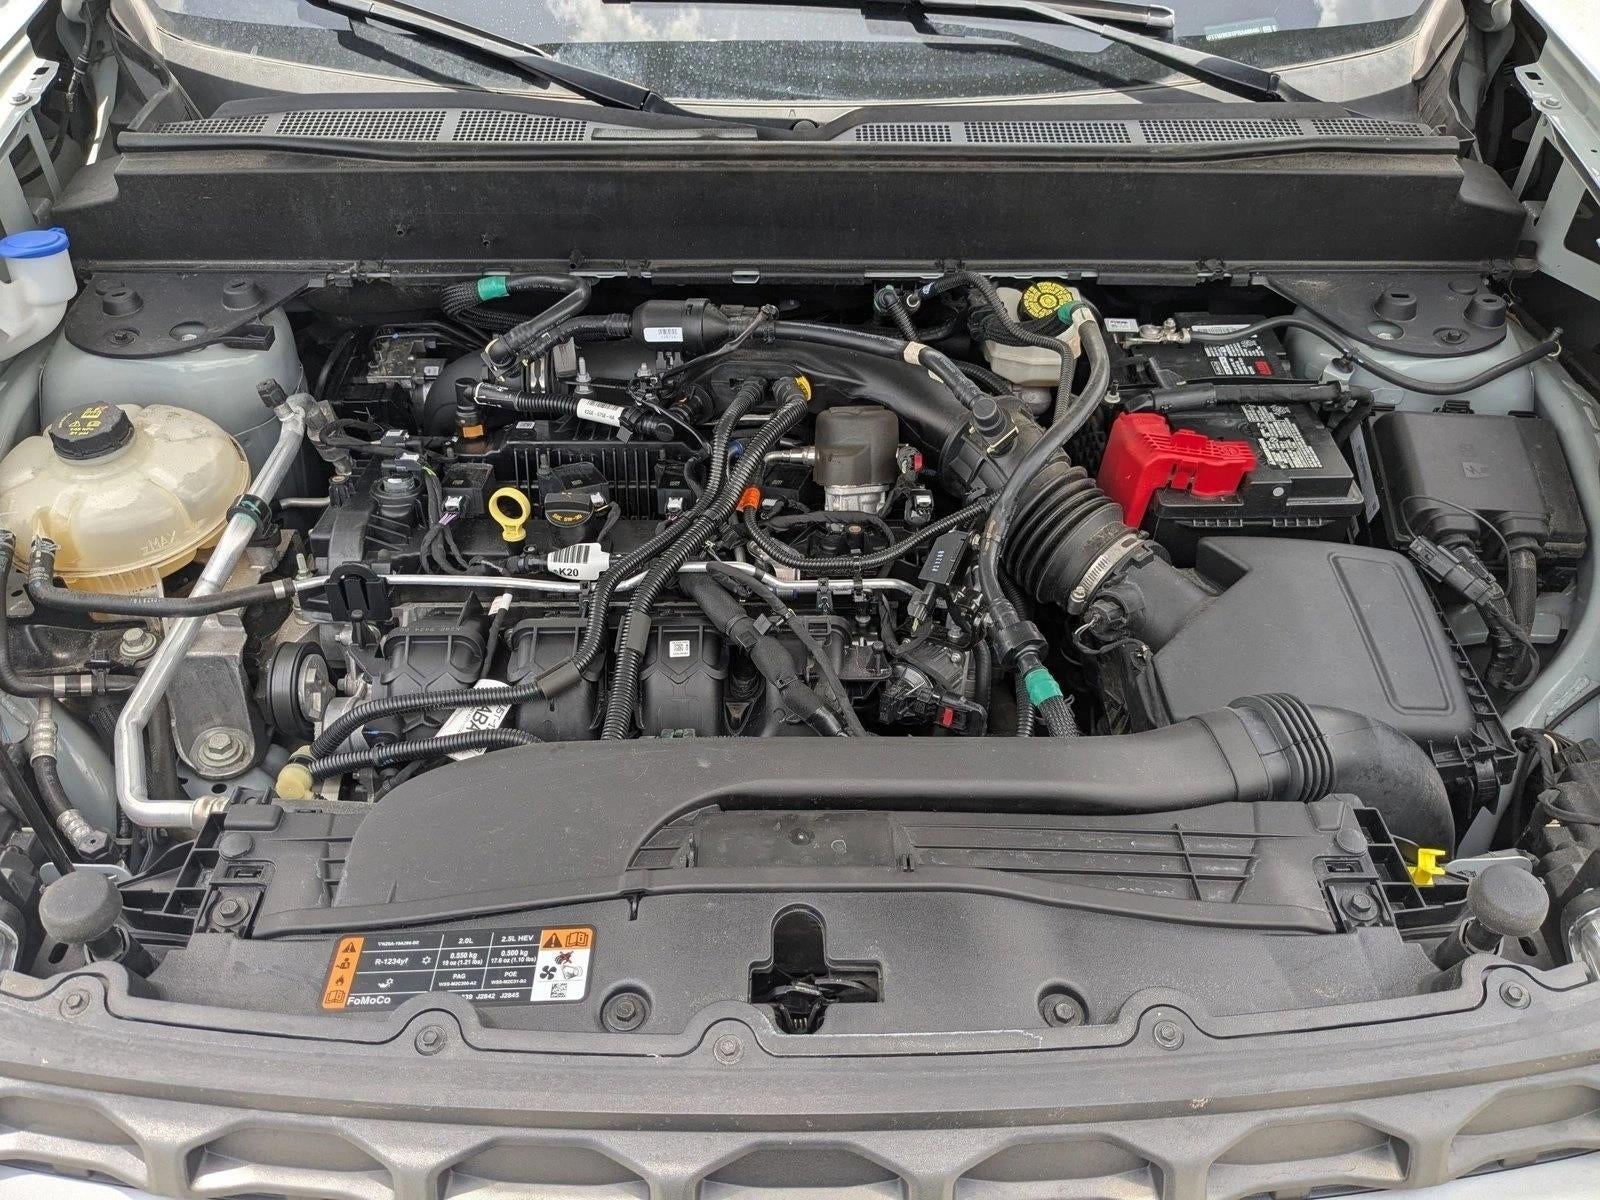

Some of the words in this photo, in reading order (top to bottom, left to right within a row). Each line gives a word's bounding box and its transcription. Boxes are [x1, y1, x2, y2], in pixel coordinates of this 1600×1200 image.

[468, 951, 478, 960] kg
[500, 949, 519, 957] 0.500
[519, 949, 529, 957] kg
[375, 957, 409, 966] R-1234yf
[347, 995, 391, 1006] FoMoCo
